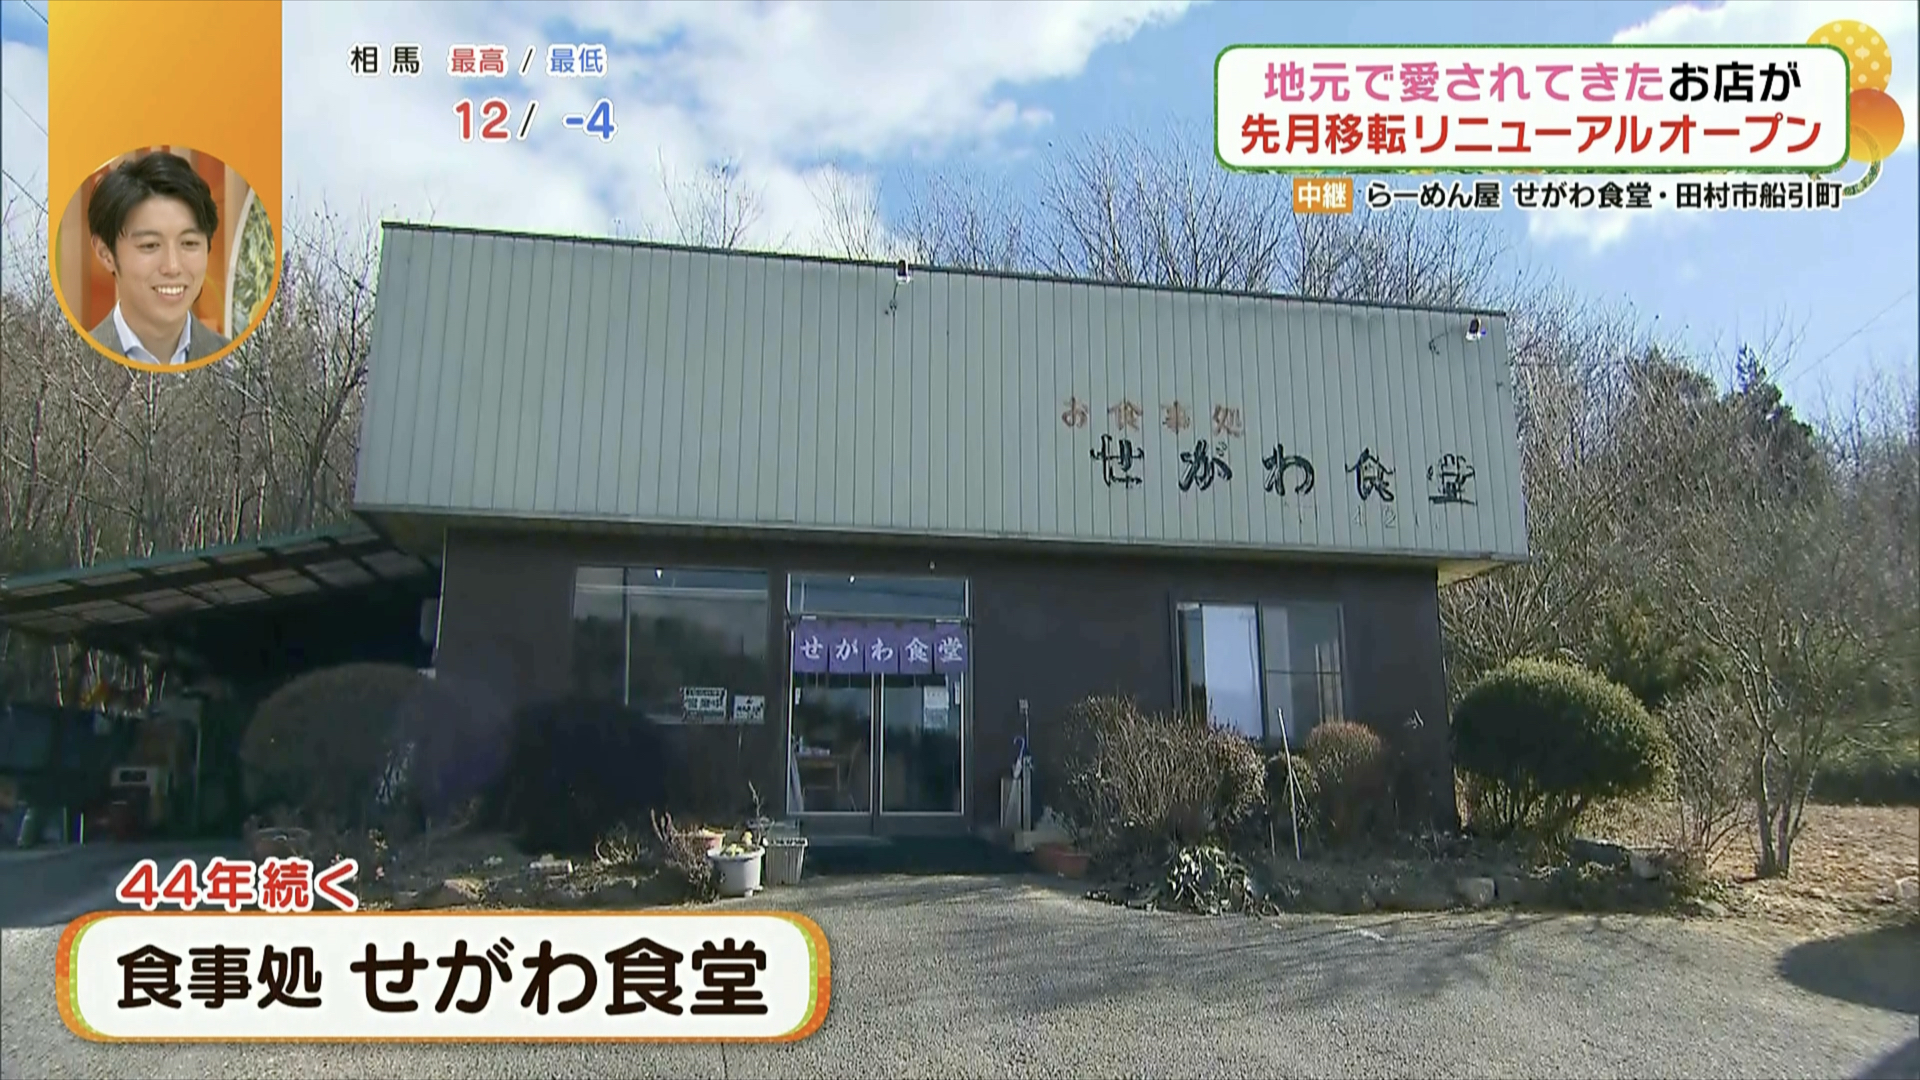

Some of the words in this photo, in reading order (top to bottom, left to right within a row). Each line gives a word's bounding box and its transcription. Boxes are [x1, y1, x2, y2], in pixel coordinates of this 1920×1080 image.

[1090, 432, 1477, 505] せがわ食堂
[800, 636, 963, 663] せがわ食堂
